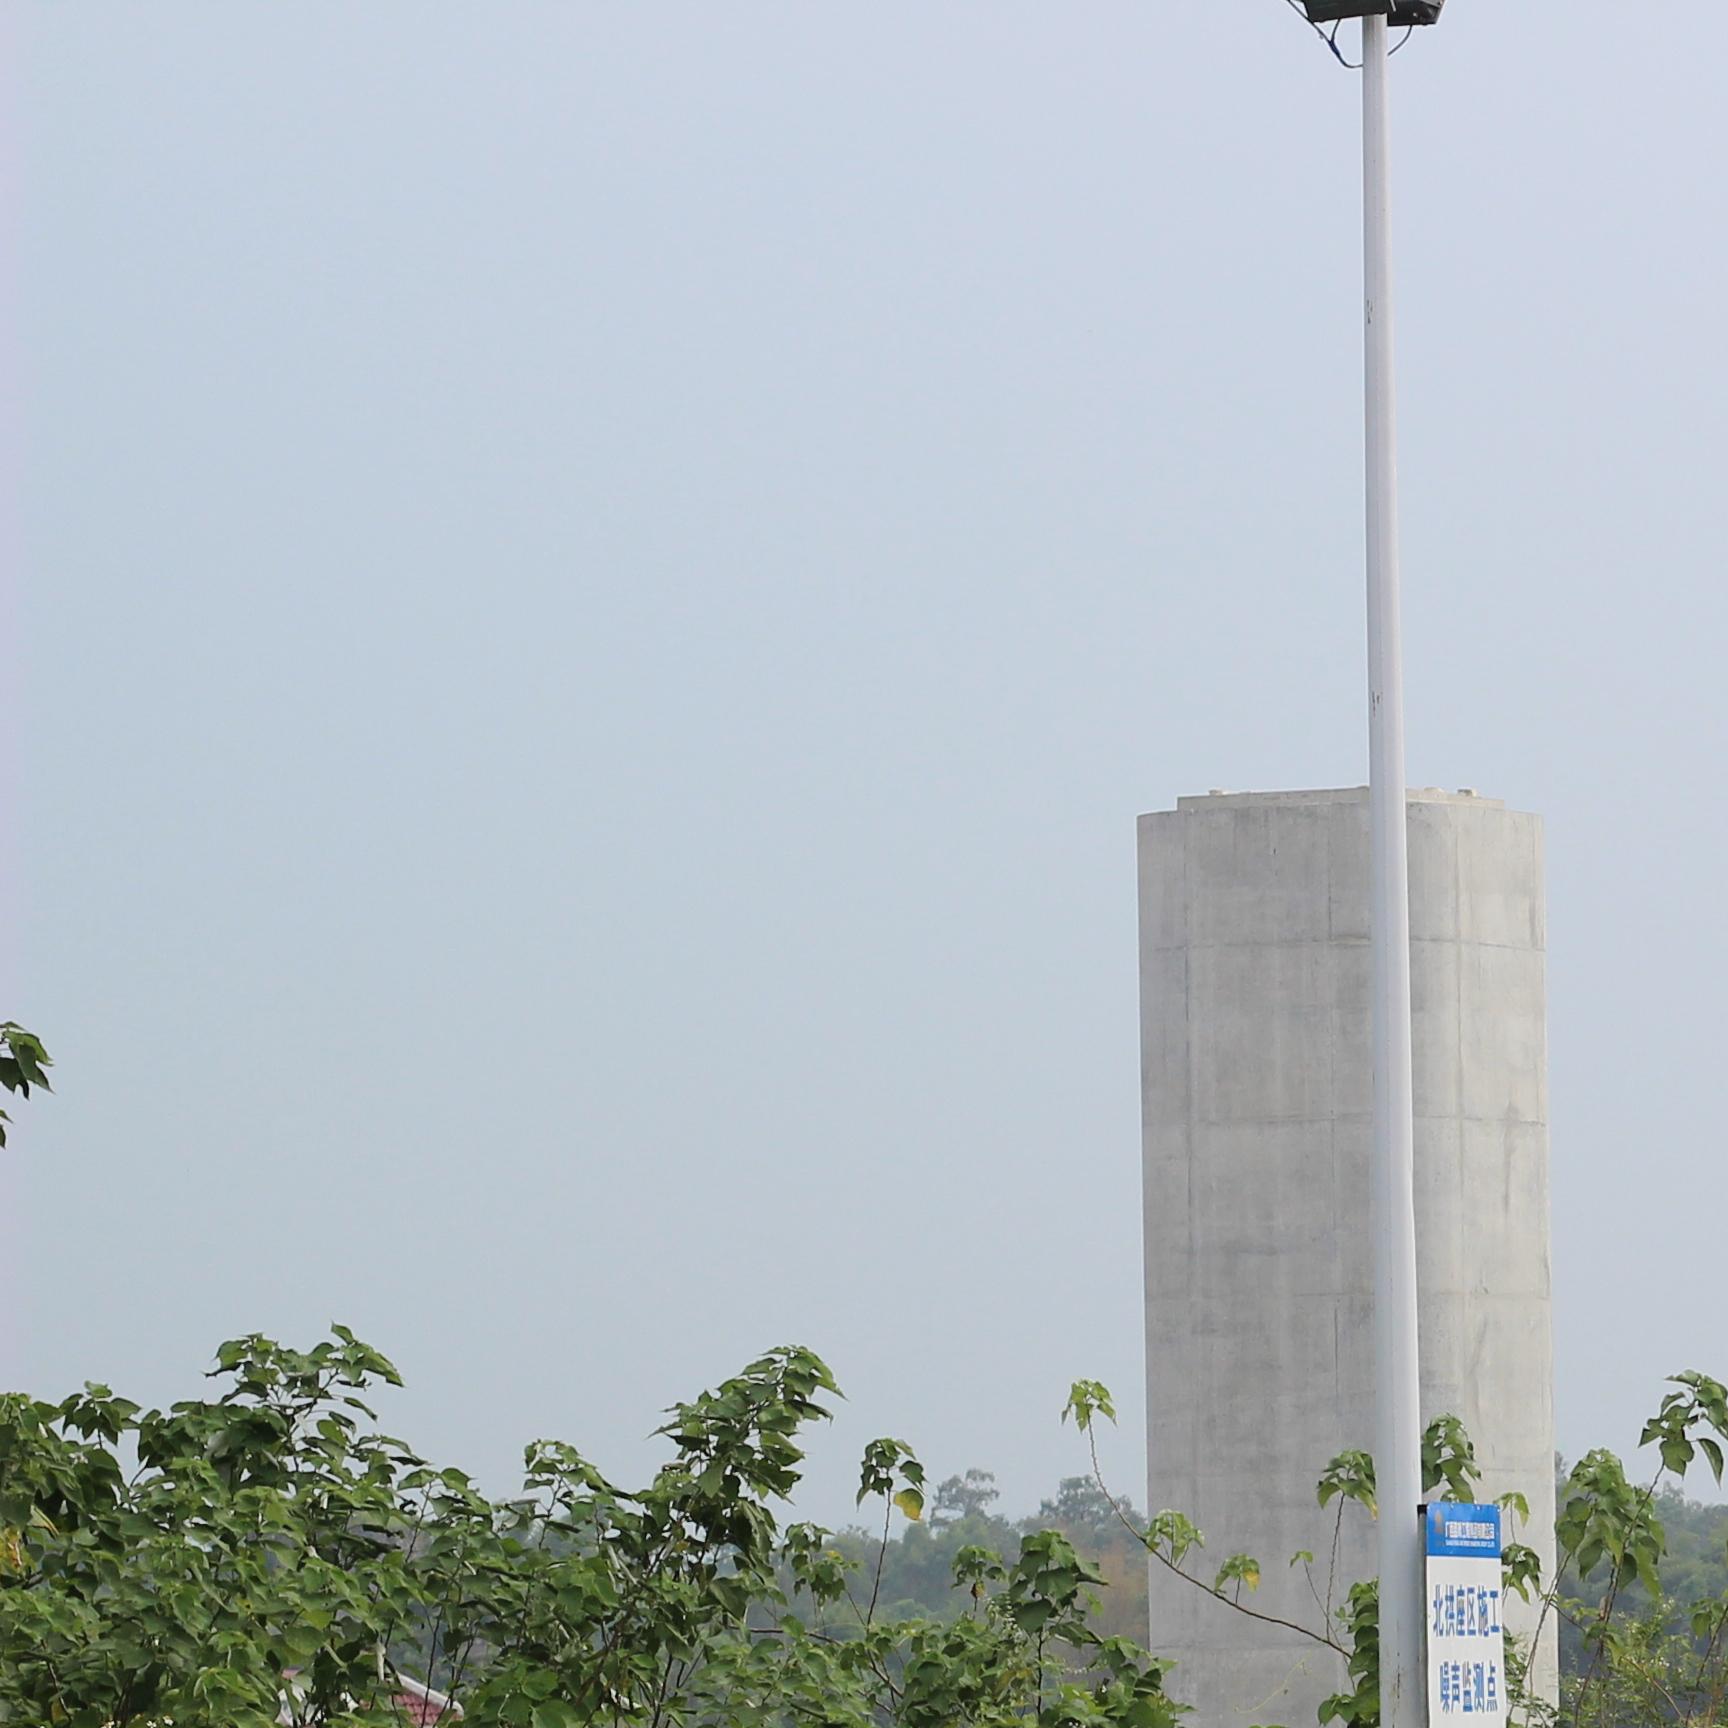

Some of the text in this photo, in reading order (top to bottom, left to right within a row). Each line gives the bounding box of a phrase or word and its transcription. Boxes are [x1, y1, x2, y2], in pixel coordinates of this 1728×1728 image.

[1433, 1583, 1500, 1637] 北拱座区施工
[1440, 1659, 1499, 1714] 噪声监测点
